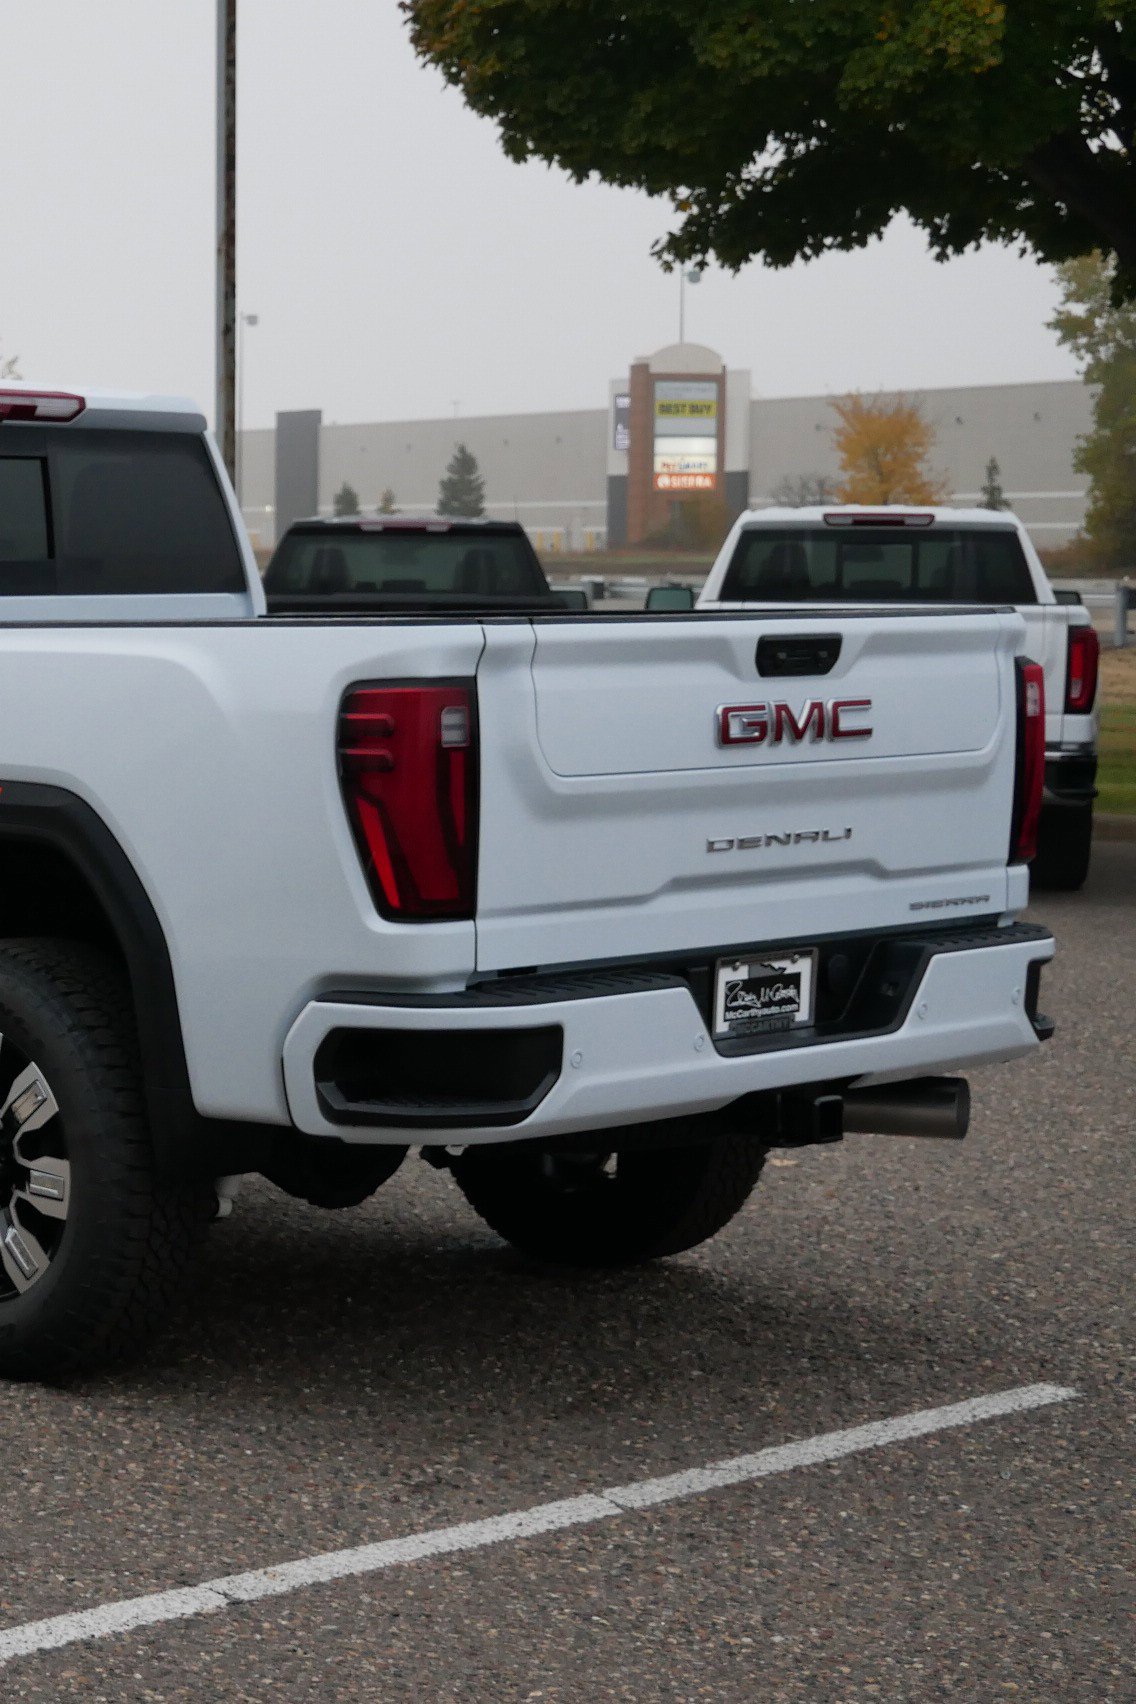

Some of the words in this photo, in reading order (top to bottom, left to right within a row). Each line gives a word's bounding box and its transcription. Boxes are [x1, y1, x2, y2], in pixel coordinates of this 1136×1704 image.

[658, 403, 686, 414] BEST
[688, 403, 711, 414] BUY
[670, 475, 712, 487] SIERRA
[716, 698, 874, 748] GMC
[706, 827, 853, 853] DENALI
[909, 895, 991, 911] SIERRA
